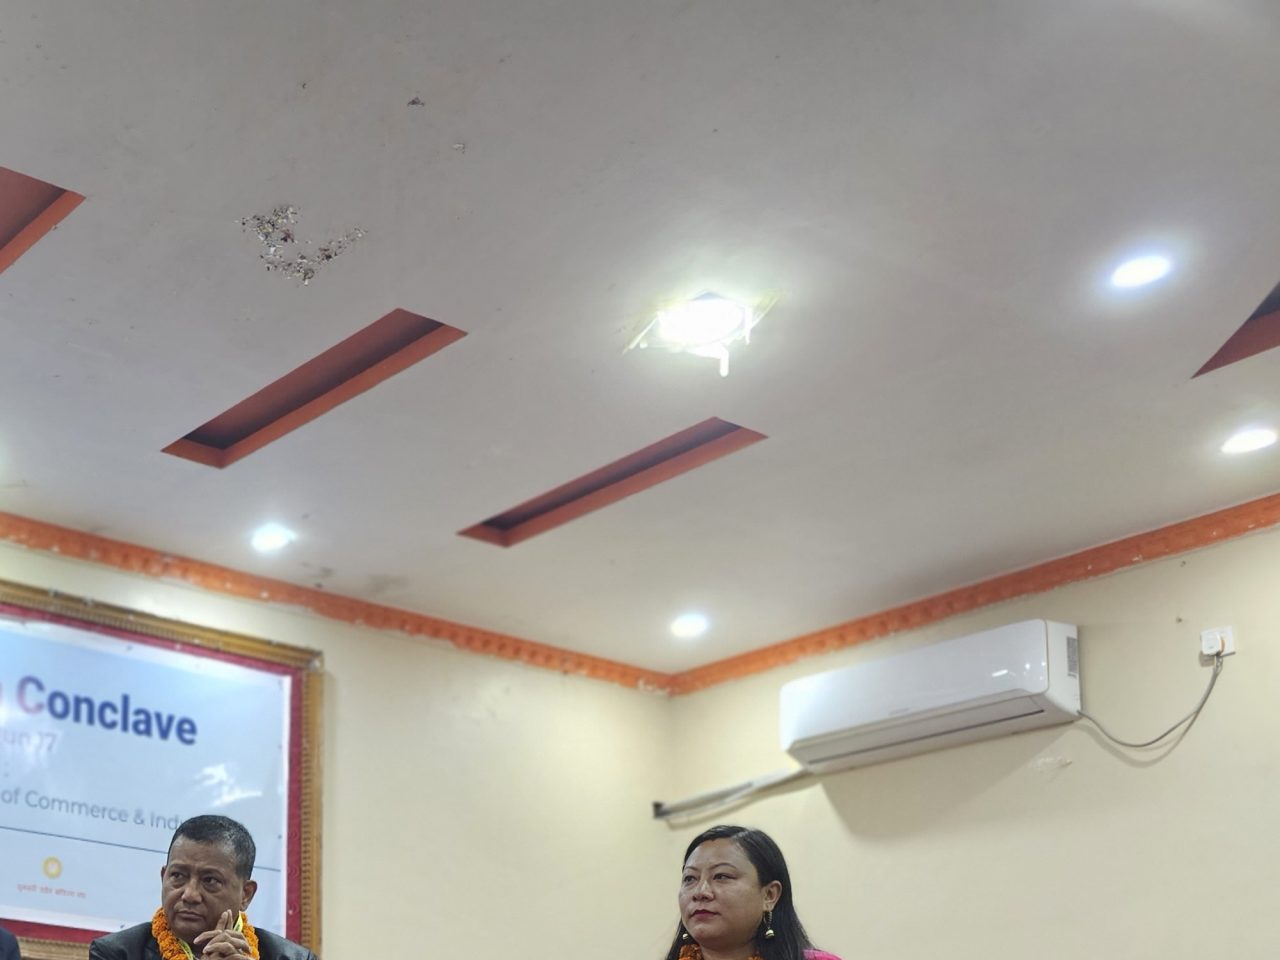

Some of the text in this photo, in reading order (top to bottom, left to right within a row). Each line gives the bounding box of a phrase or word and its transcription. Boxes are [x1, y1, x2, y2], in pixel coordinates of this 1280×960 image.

[16, 675, 198, 746] Conclave
[1, 787, 20, 804] of
[25, 789, 129, 823] Commerce
[133, 808, 146, 825] &
[150, 812, 182, 831] Ind
